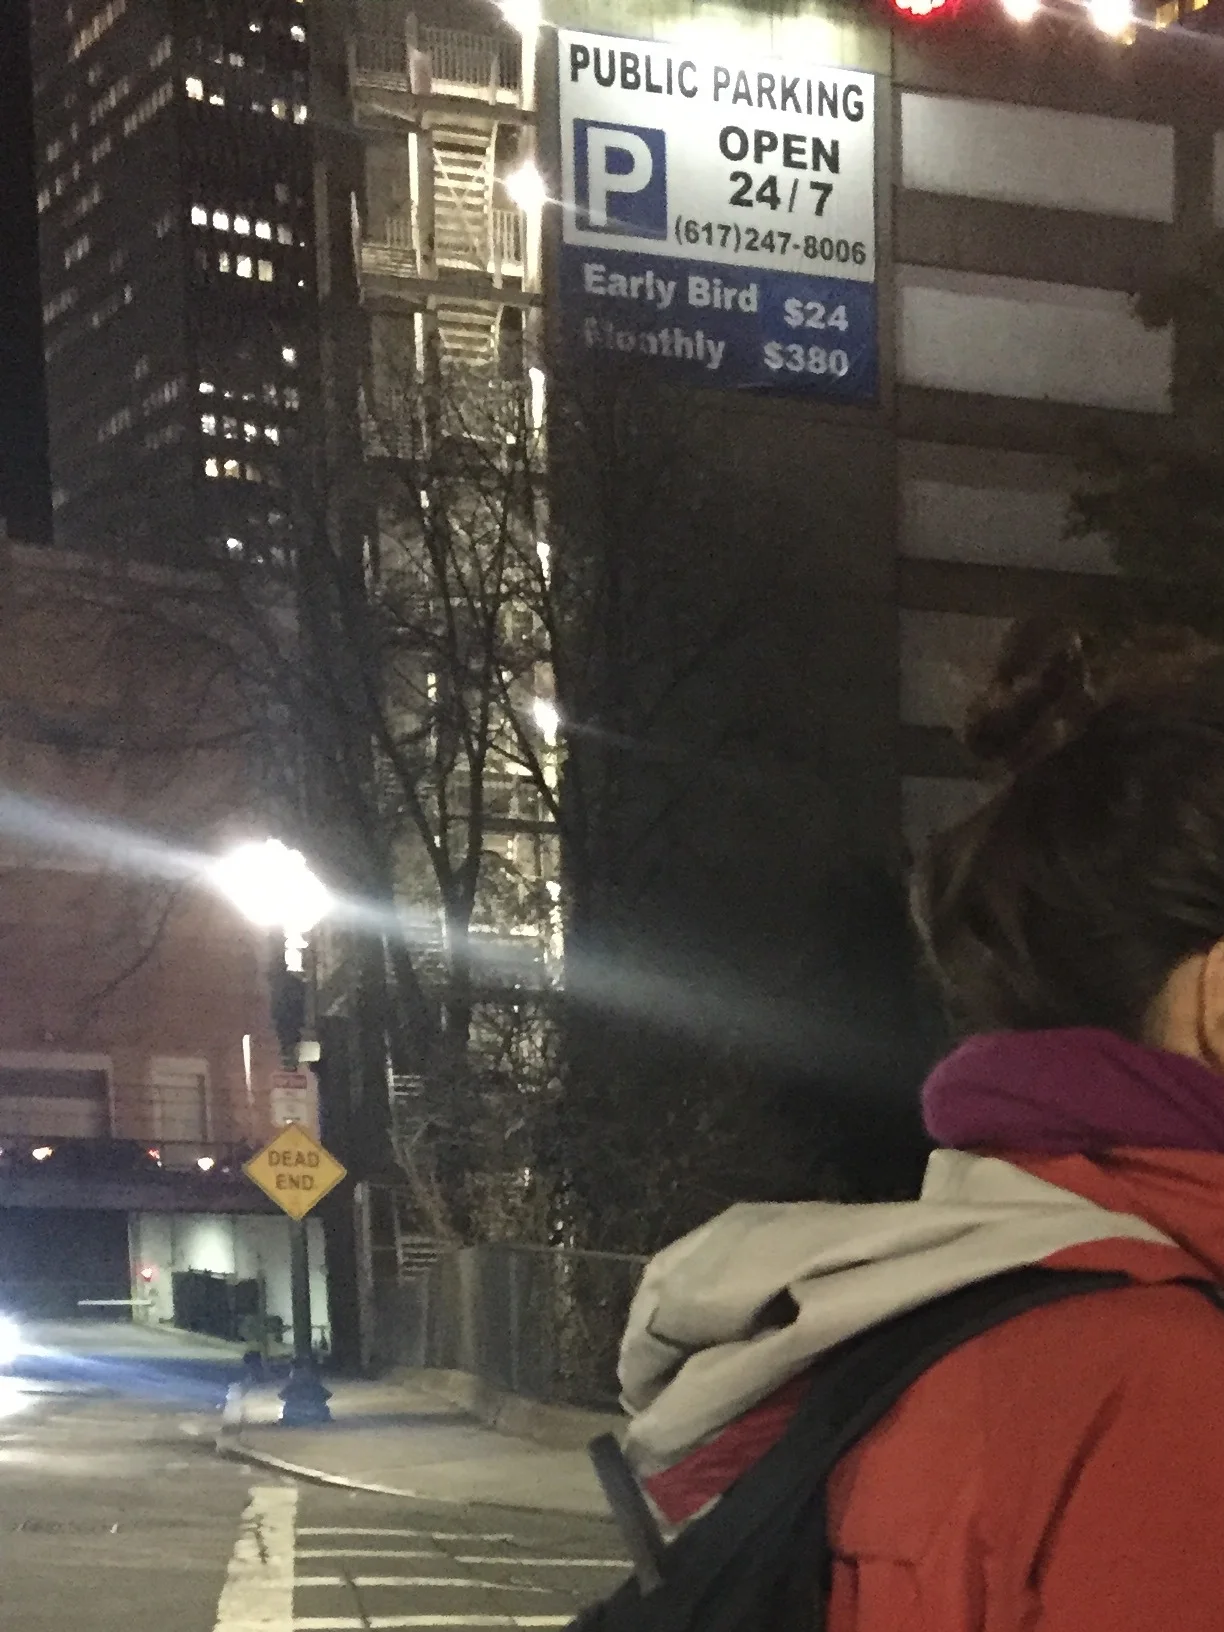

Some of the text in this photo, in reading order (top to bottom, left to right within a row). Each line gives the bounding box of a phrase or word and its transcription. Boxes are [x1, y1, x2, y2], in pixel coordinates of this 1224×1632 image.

[570, 43, 865, 122] PUBLIC PARKING
[719, 125, 840, 174] OPEN
[586, 126, 654, 228] P
[729, 171, 834, 217] 24/7
[675, 215, 867, 265] (617)247-8006
[583, 263, 849, 332] Early Bird $24
[763, 341, 850, 378] $380
[267, 1150, 320, 1191] DEAD END
